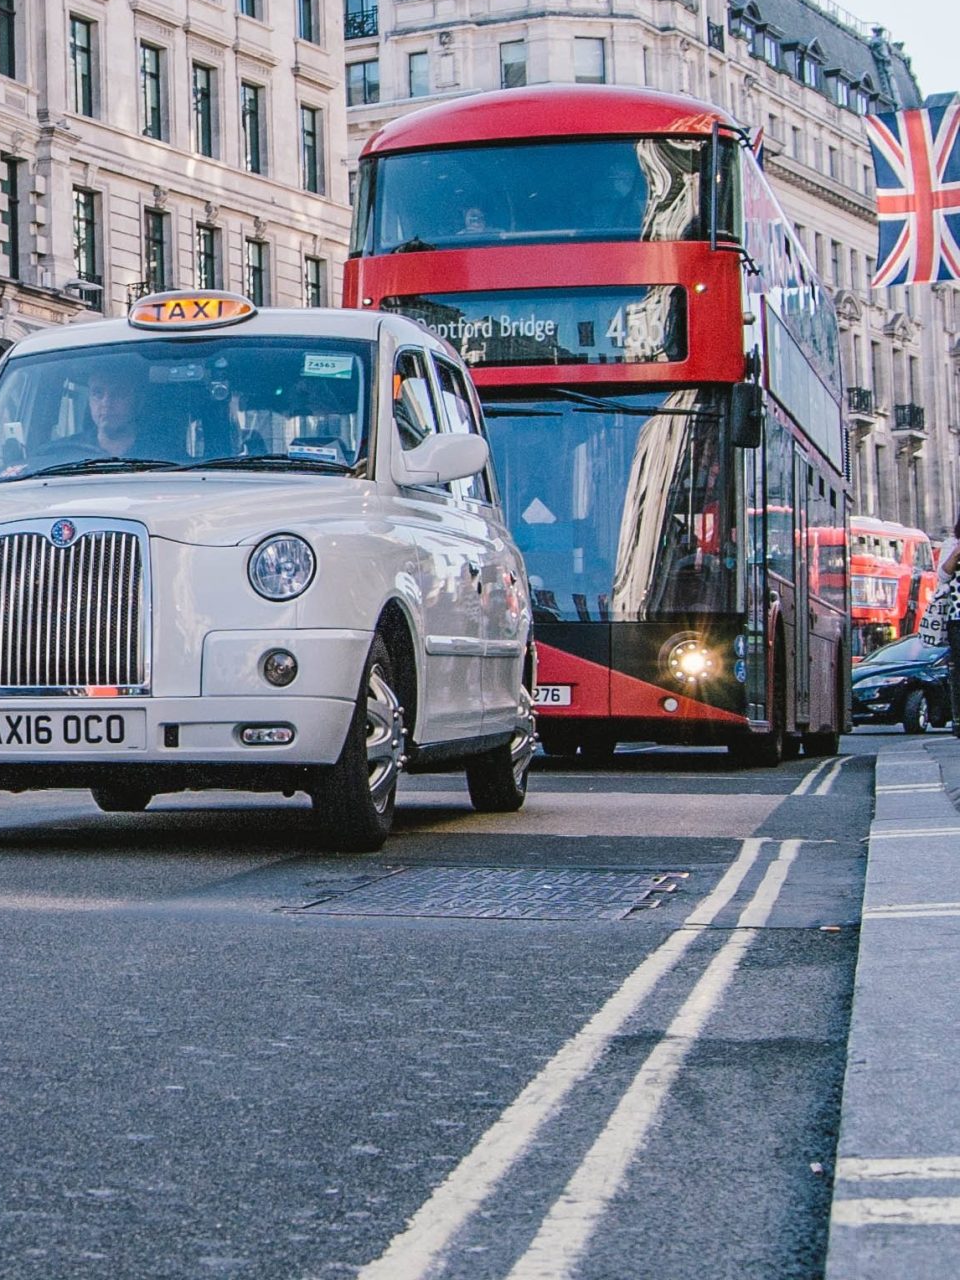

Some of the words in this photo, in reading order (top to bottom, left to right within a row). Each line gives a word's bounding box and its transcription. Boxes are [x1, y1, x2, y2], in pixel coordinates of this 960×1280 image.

[152, 300, 223, 321] TAXI
[500, 313, 555, 341] Bridge
[63, 714, 125, 744] OCO
